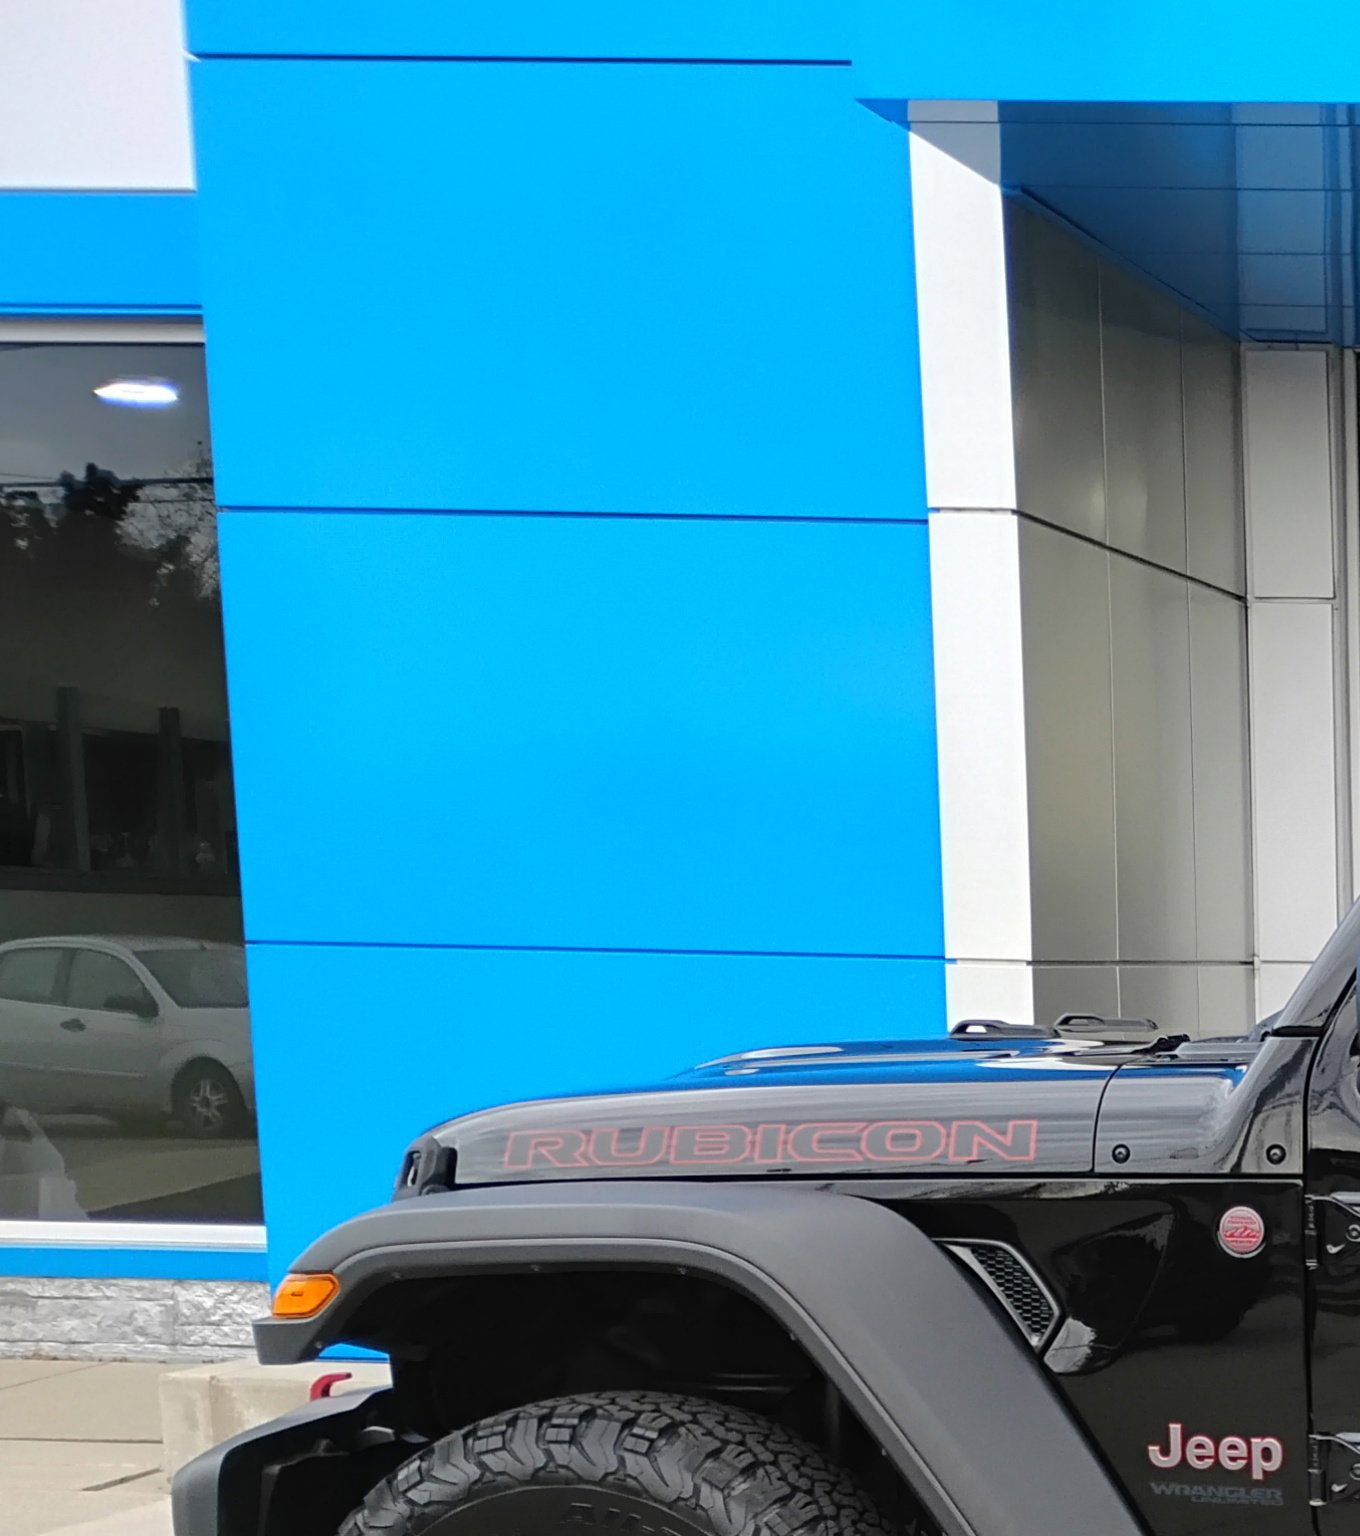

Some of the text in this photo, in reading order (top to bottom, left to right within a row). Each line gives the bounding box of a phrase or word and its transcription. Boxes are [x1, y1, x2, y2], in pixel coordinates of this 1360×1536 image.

[503, 1120, 1039, 1171] RUBICON
[1147, 1423, 1284, 1480] Jeep
[1149, 1481, 1283, 1500] WRANGLER
